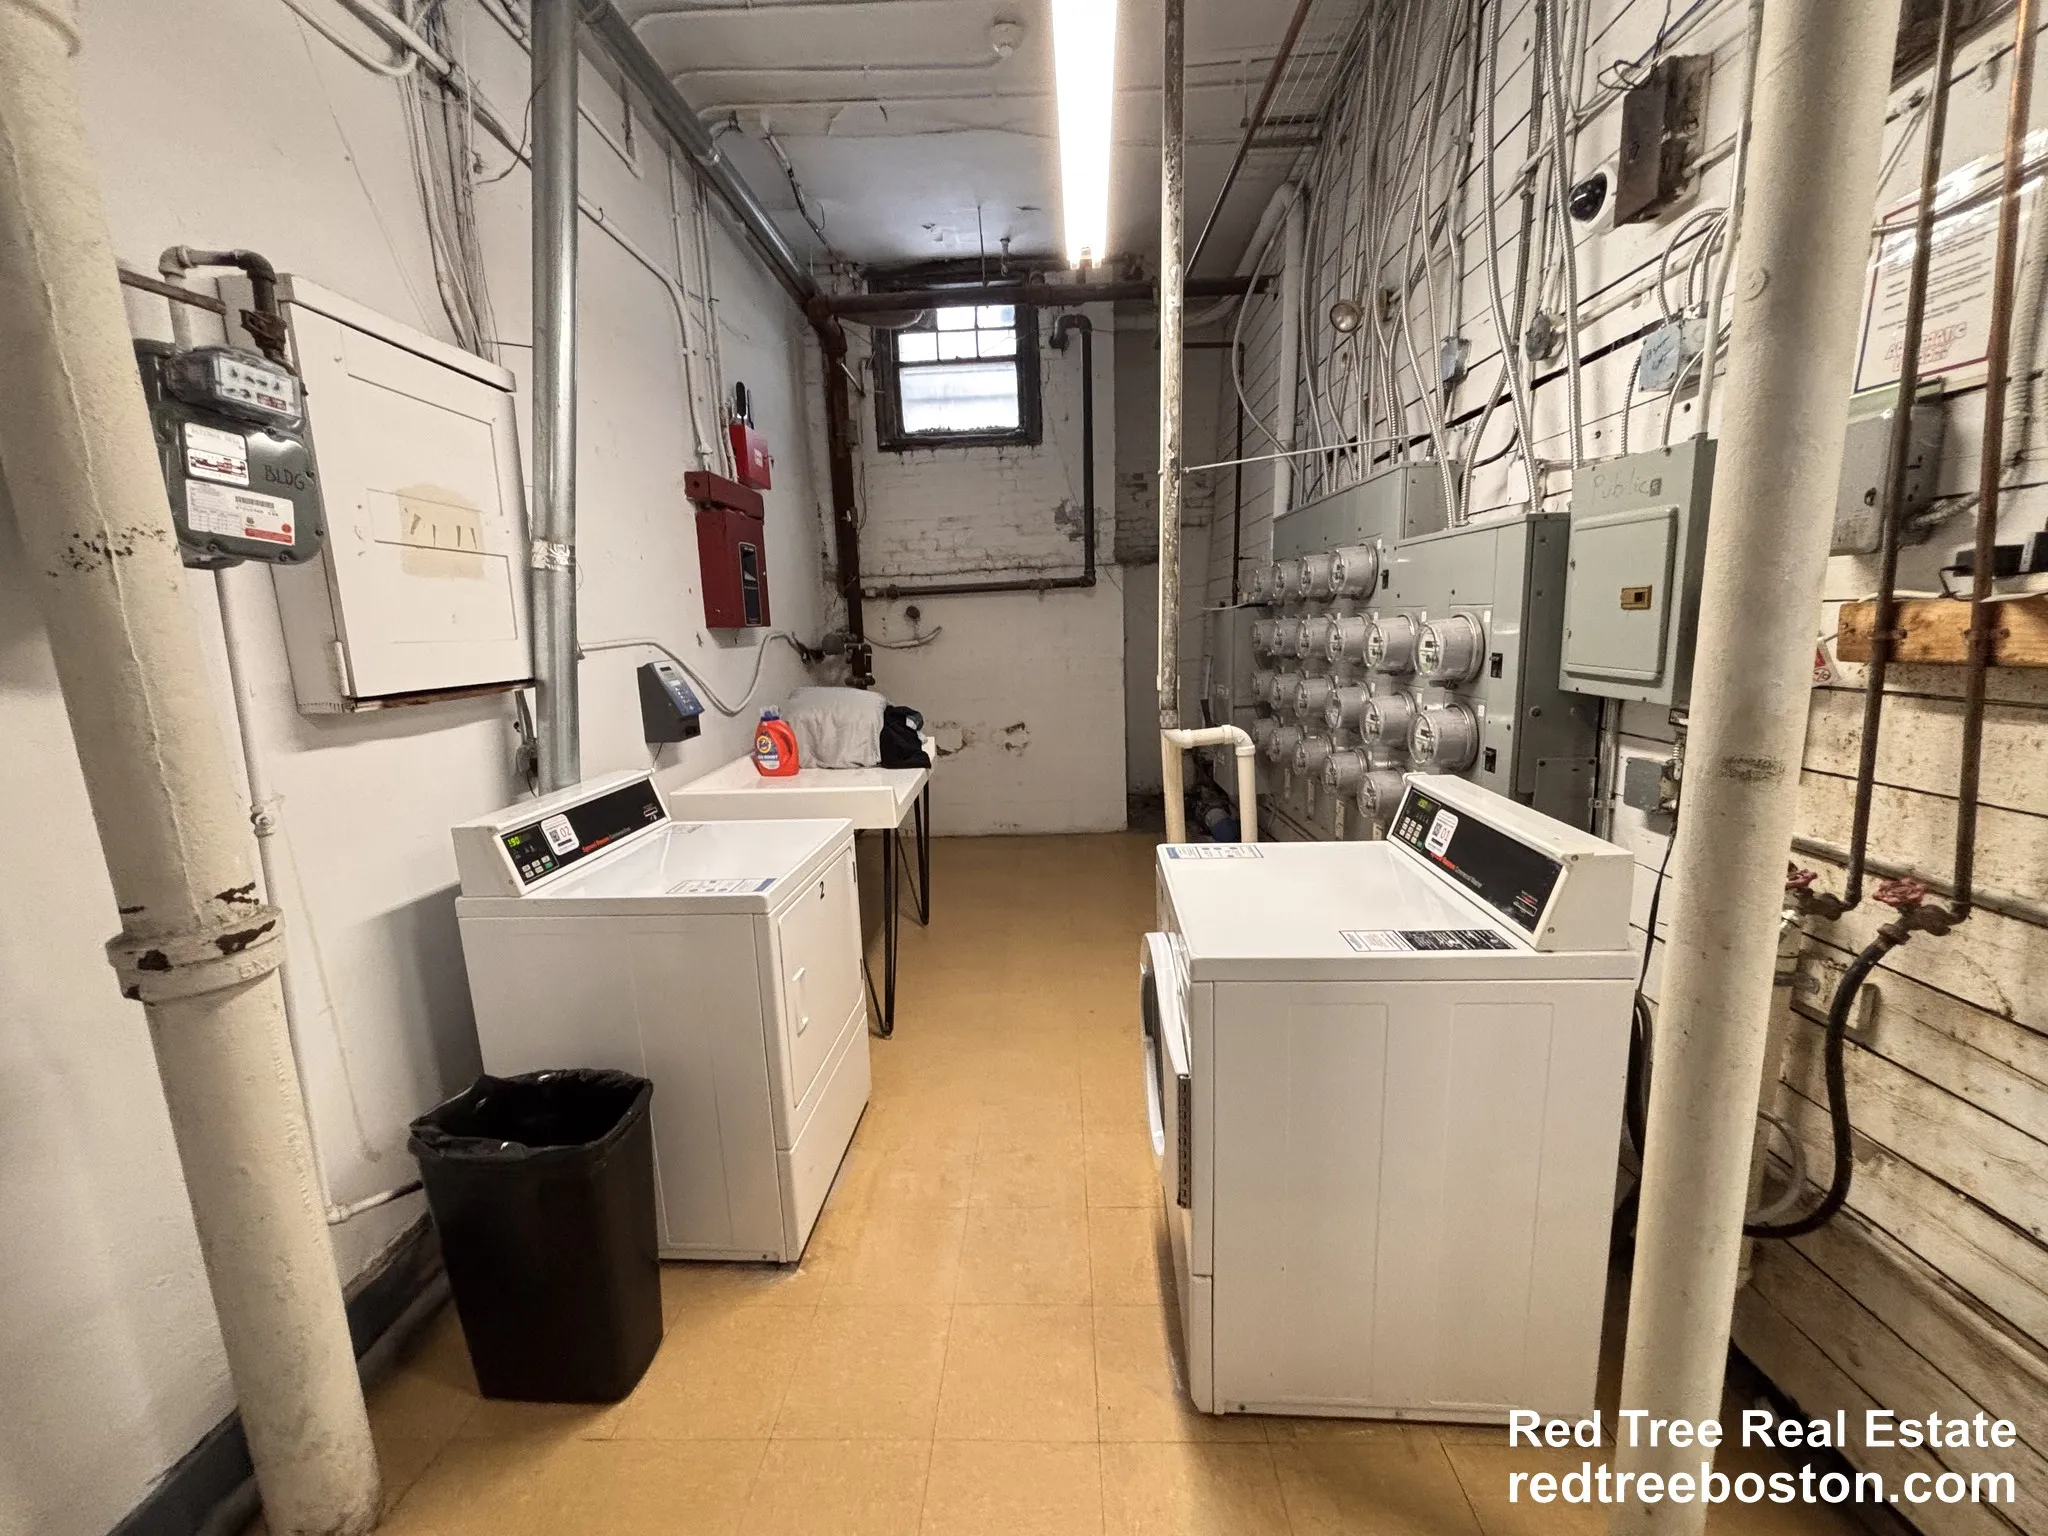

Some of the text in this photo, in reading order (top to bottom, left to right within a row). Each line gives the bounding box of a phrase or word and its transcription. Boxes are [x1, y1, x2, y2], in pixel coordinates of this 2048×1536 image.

[264, 465, 305, 491] BLDG
[560, 825, 572, 838] 02
[1440, 827, 1451, 842] 01
[819, 880, 825, 900] 2
